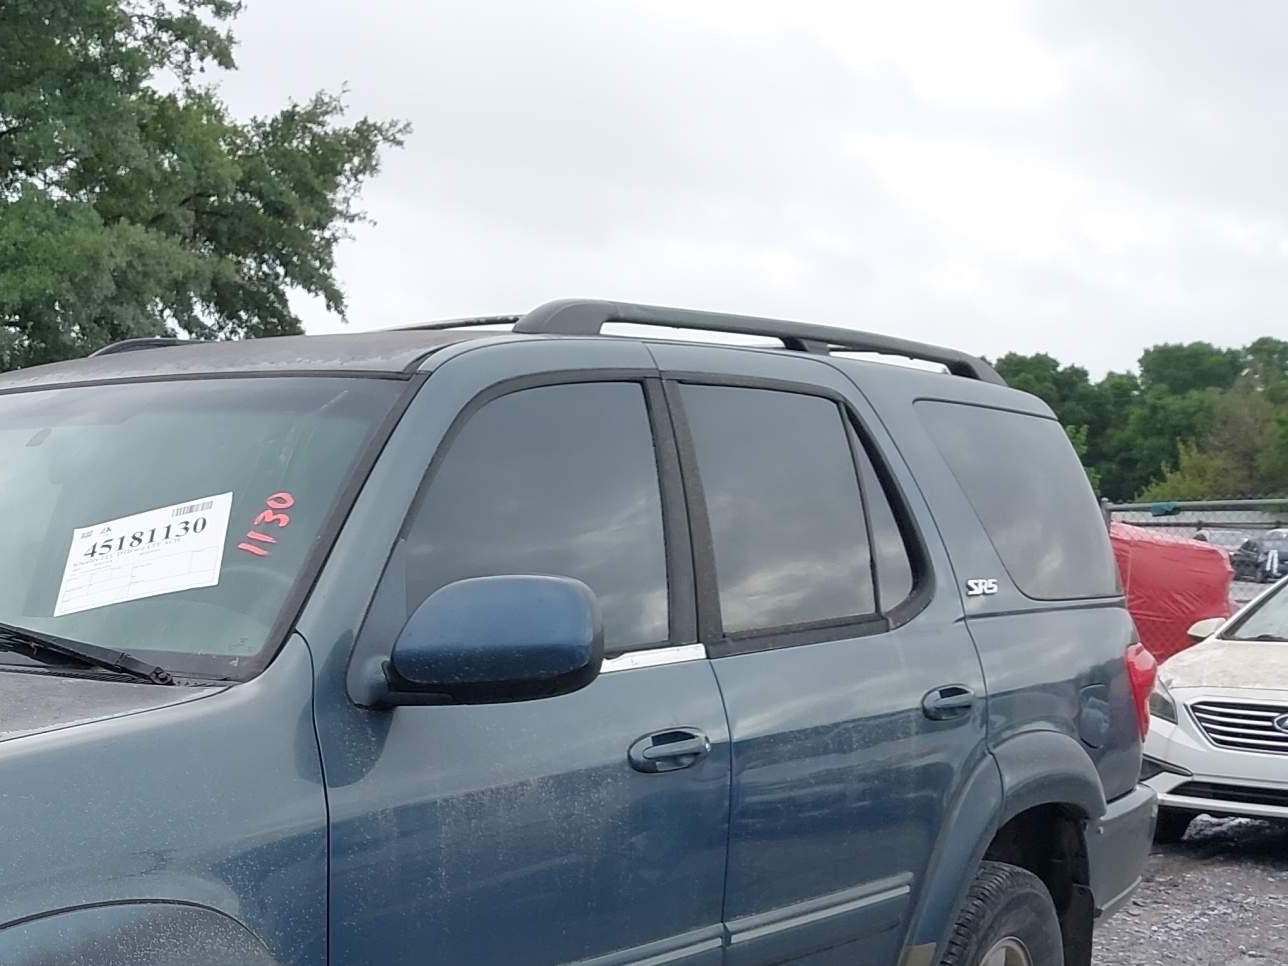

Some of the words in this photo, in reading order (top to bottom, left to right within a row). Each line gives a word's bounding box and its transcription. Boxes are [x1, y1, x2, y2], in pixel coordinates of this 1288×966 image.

[83, 517, 207, 558] 45181130
[237, 492, 295, 556] 1130
[967, 579, 998, 595] SR5
